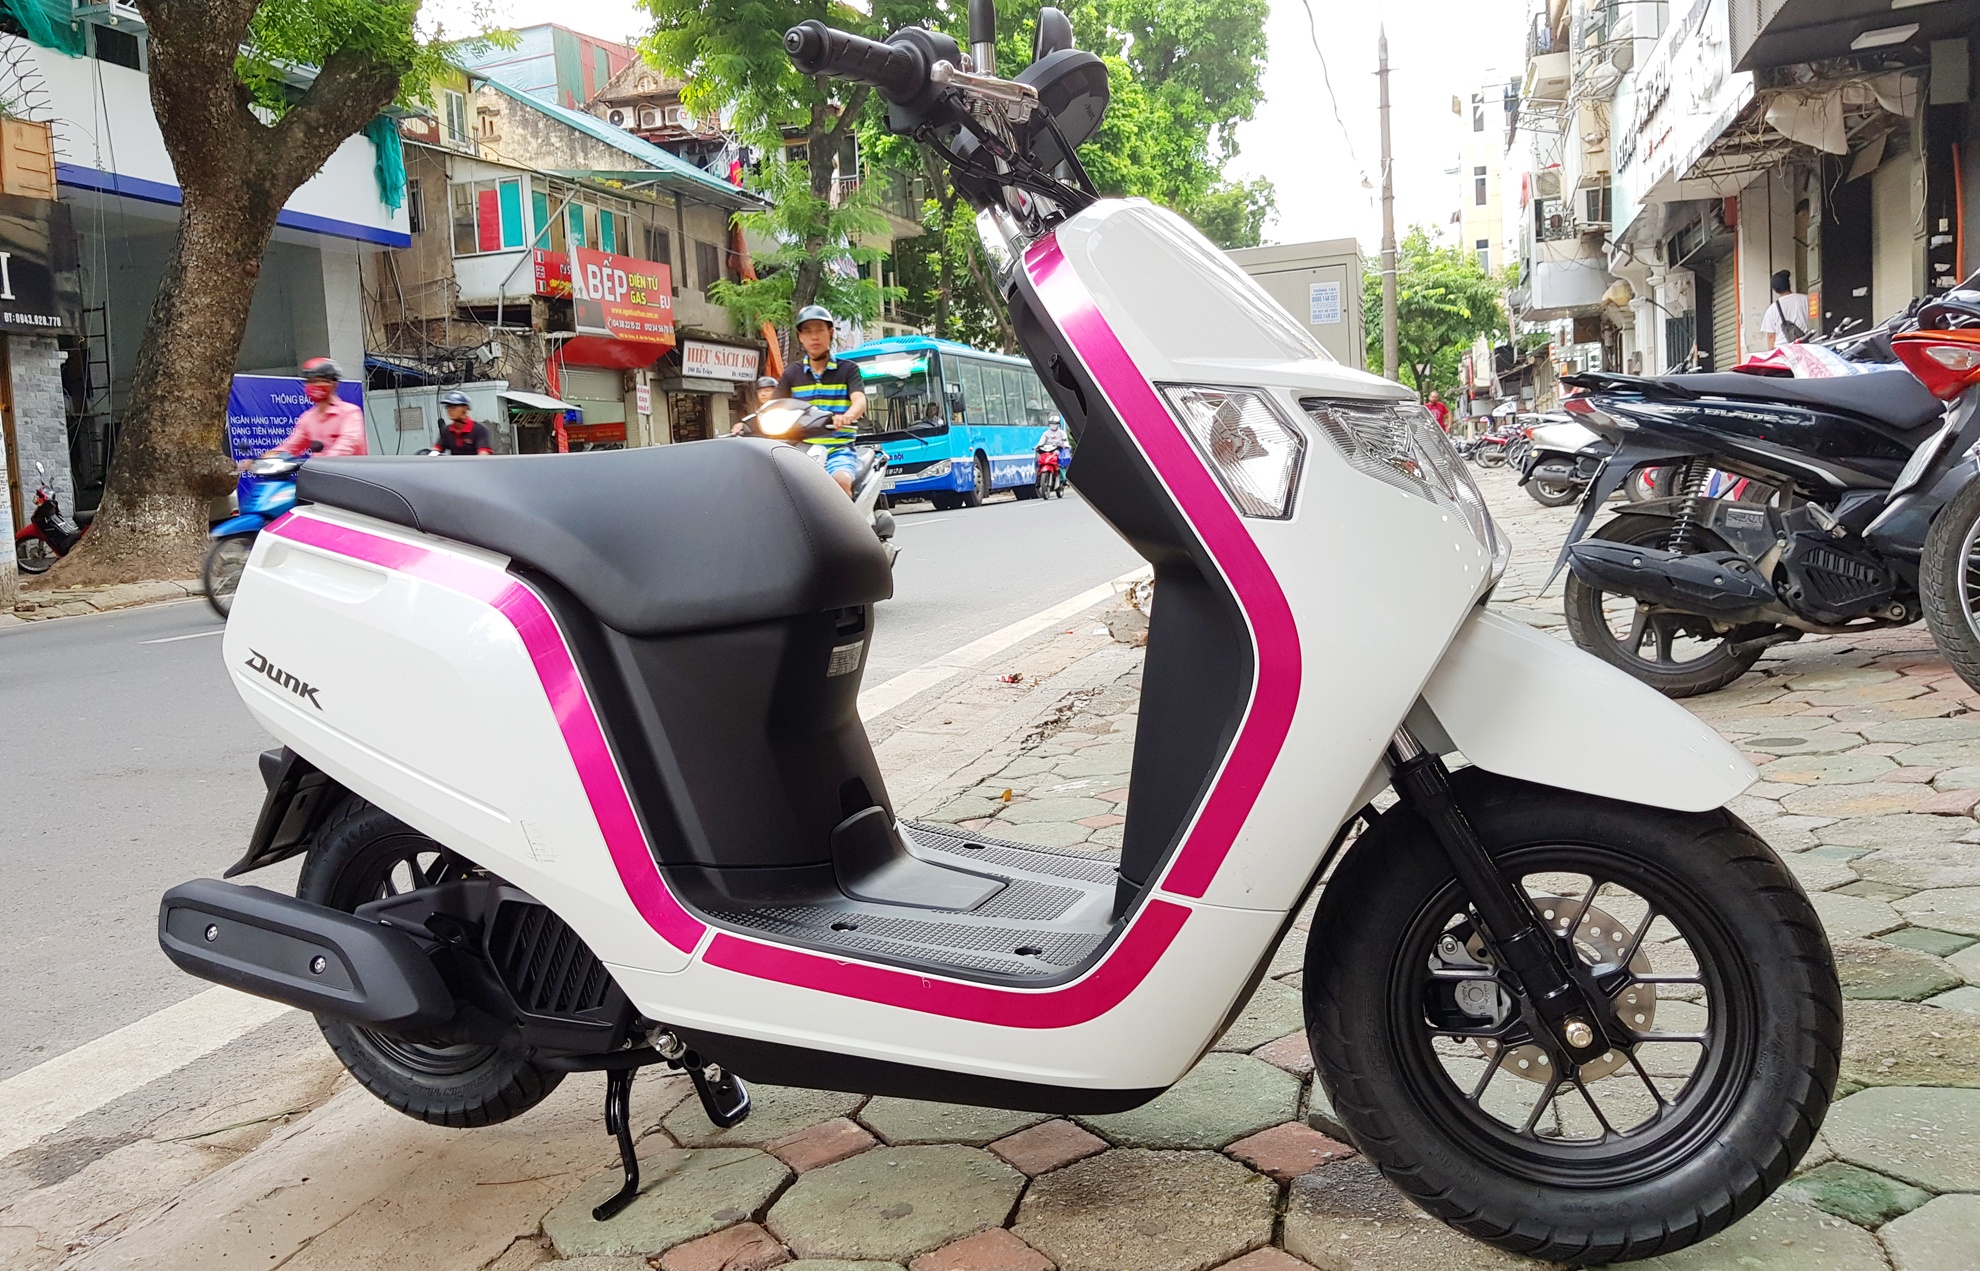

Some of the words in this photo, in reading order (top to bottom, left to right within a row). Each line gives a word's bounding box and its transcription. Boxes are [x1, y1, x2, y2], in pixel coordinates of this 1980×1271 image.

[587, 256, 628, 302] BẾP
[687, 345, 712, 367] HIỆU
[714, 348, 739, 368] SÁCH
[741, 354, 757, 369] 180
[270, 392, 298, 404] THÔNG
[230, 415, 250, 424] NGÂN
[251, 415, 269, 425] HÀNG
[270, 417, 287, 425] TMCP
[231, 427, 251, 435] ĐANG
[268, 426, 285, 435] HÀNH
[249, 436, 271, 446] KHÁCH
